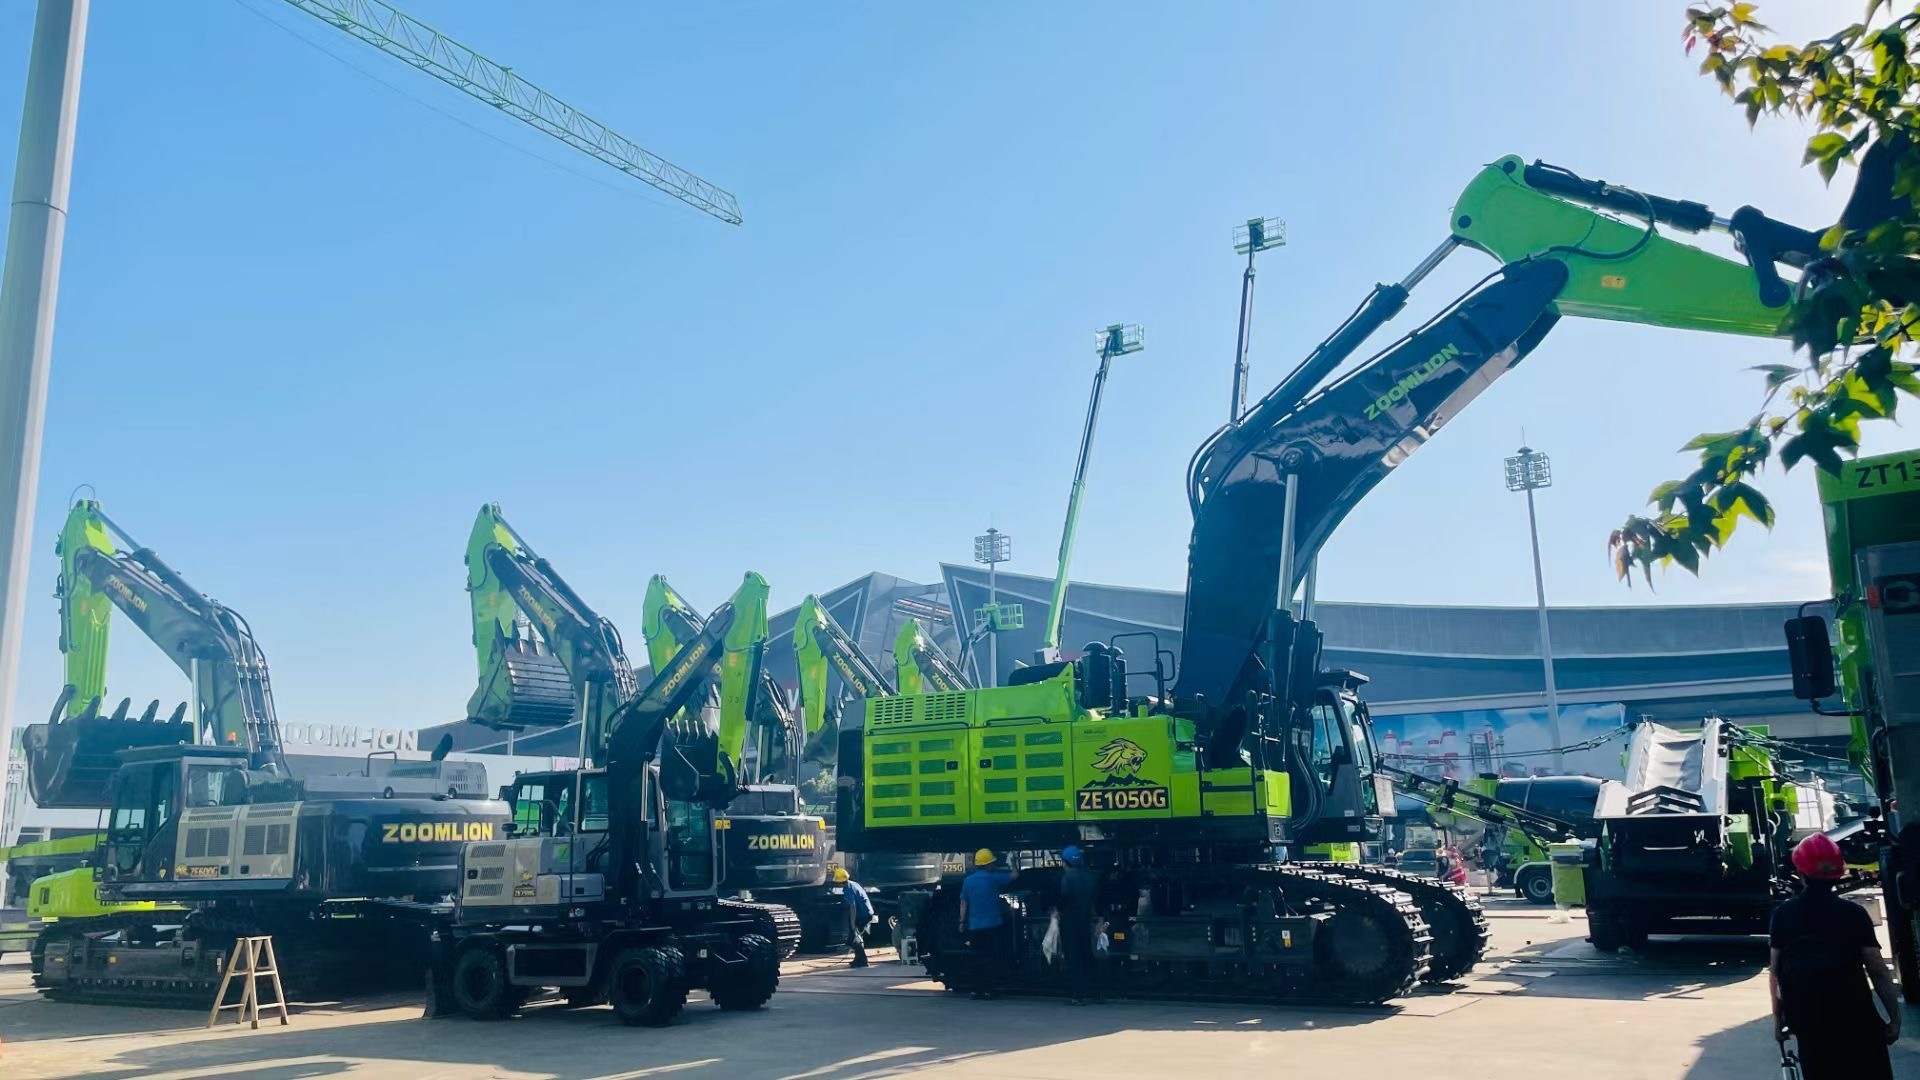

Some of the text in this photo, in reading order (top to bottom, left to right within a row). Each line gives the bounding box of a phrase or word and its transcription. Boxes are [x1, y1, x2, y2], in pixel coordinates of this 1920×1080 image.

[1363, 343, 1460, 420] ZOOMLION
[107, 574, 148, 612] ZOOMLION
[518, 584, 557, 631] ZOOMLION
[662, 643, 706, 696] ZOOMLION
[833, 652, 867, 697] ZOOMLION
[1080, 789, 1166, 810] ZE1050G
[382, 822, 493, 842] ZOOMLION
[748, 834, 814, 850] ZOOMLION
